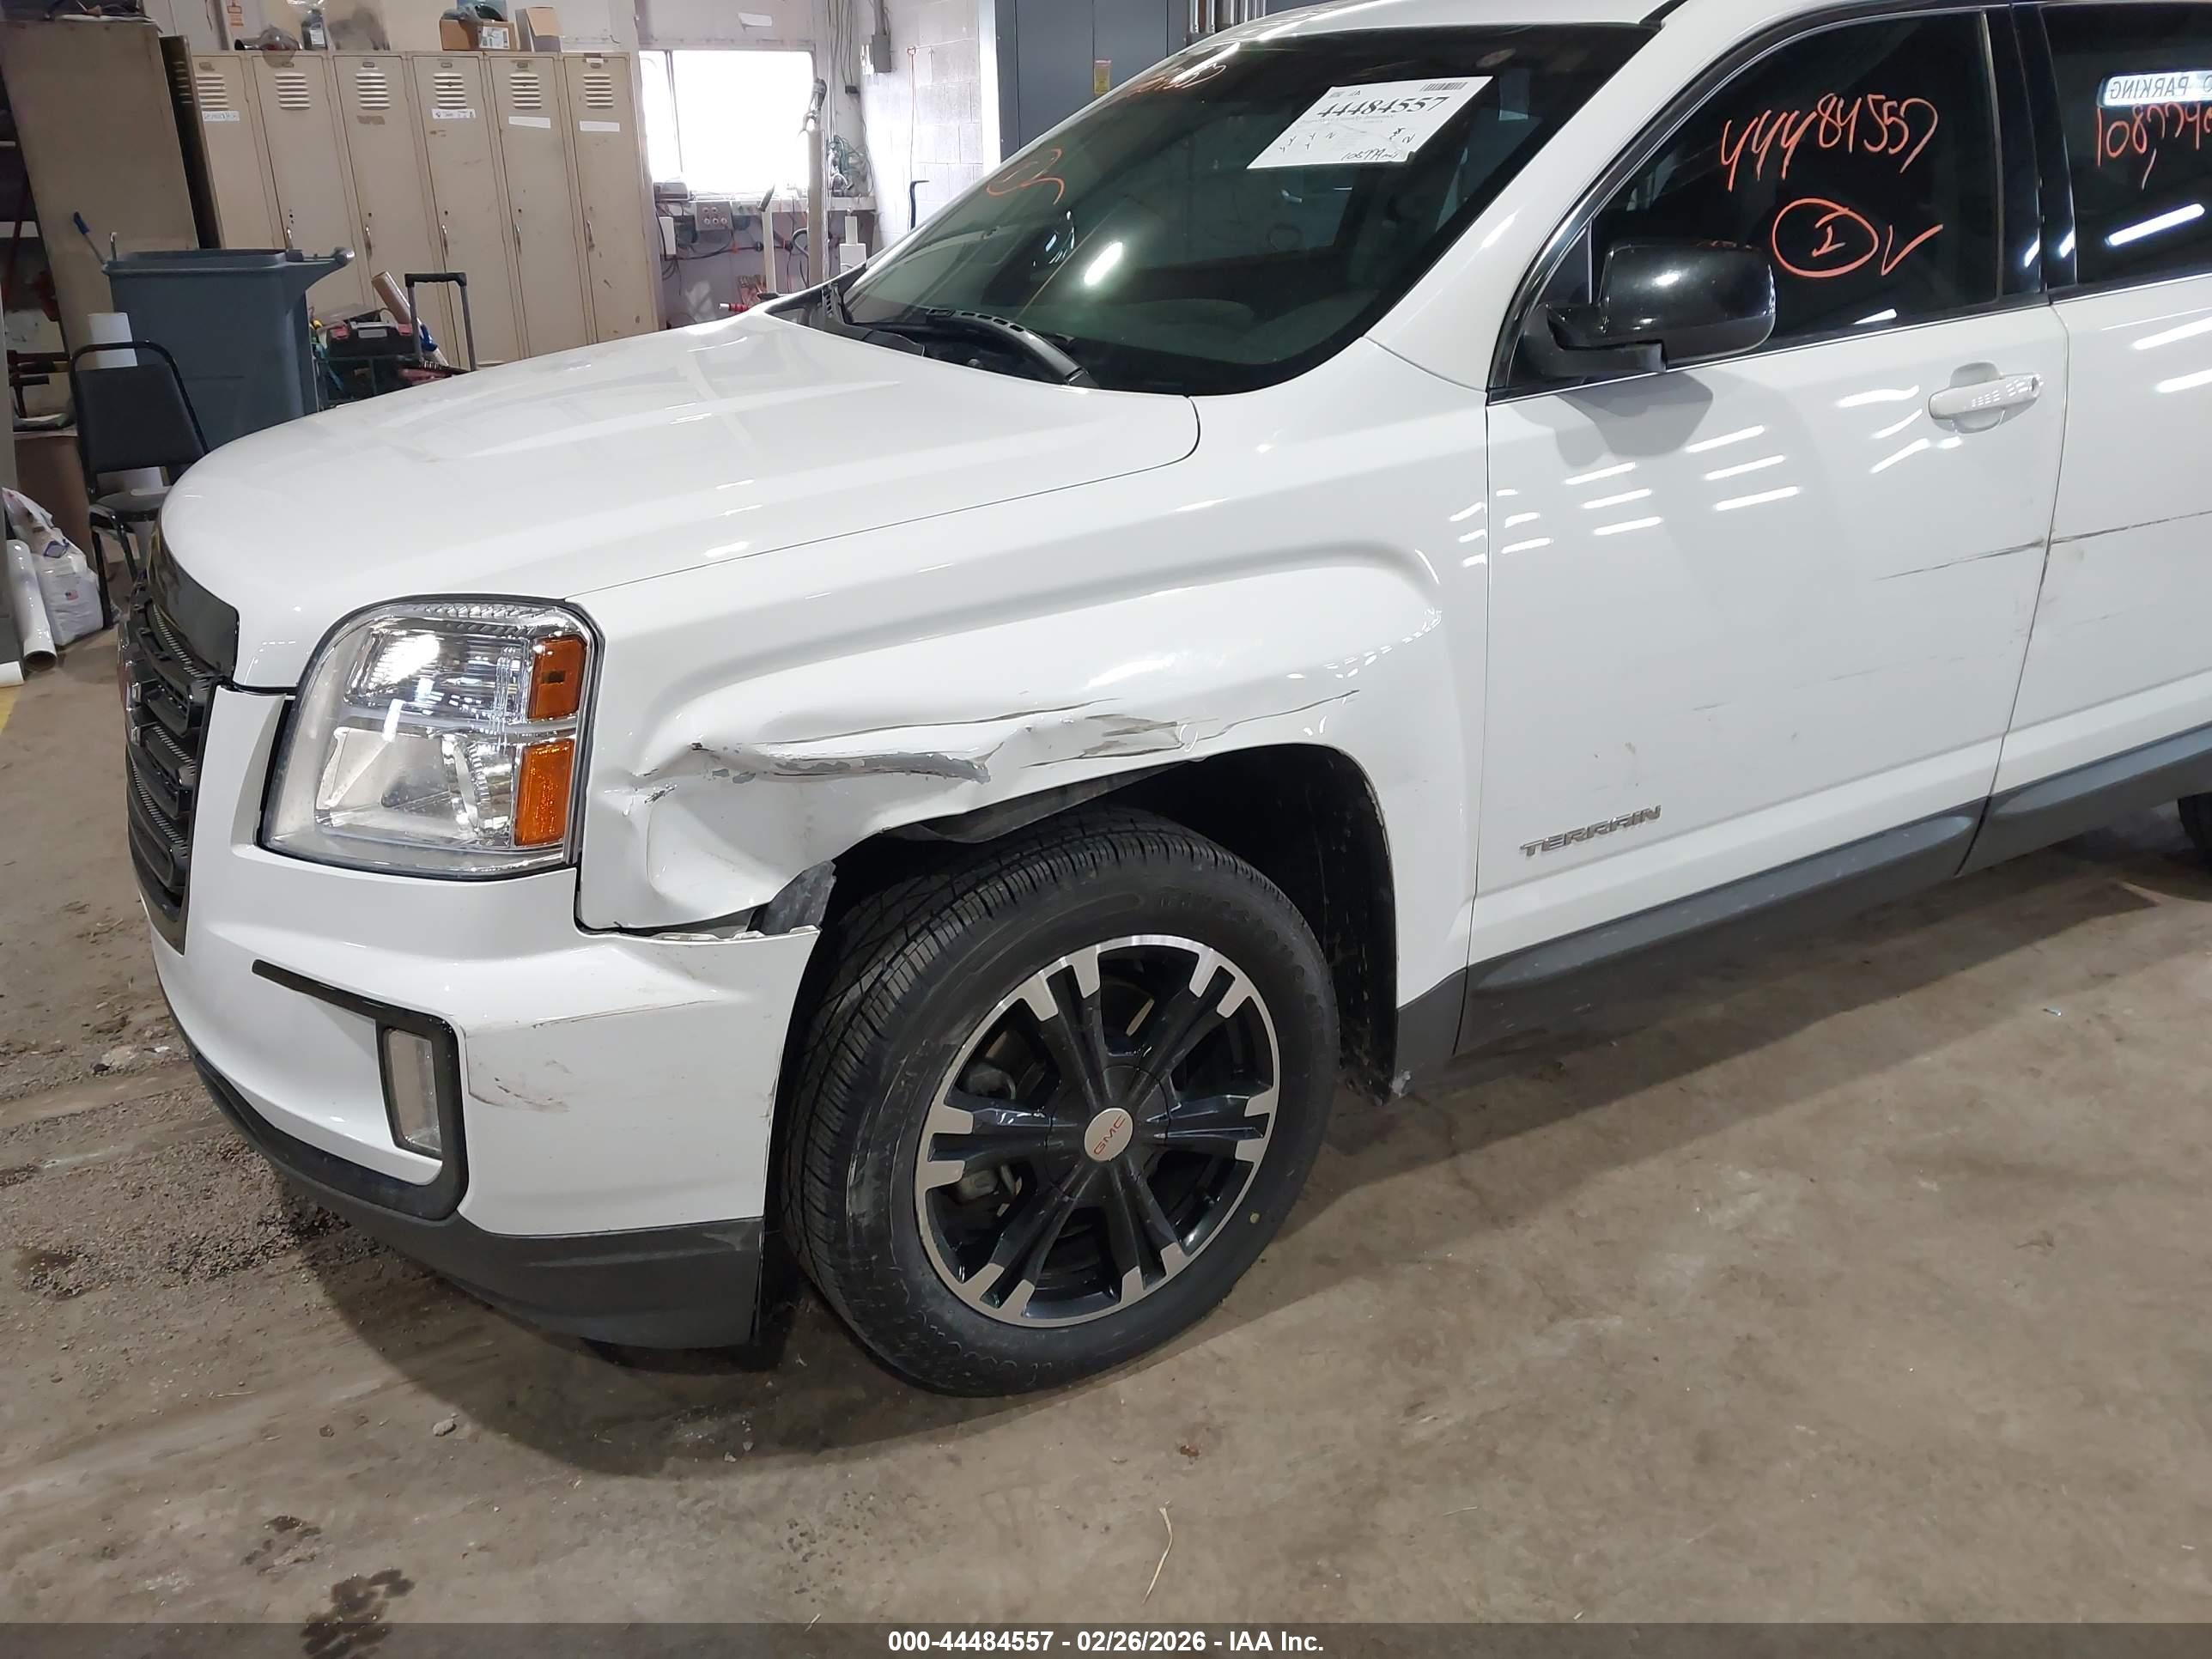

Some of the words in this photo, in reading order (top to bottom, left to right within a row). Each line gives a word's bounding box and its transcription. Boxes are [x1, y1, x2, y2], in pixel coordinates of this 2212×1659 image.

[1317, 96, 1450, 118] 44484557
[1720, 92, 1939, 189] 44484557
[1519, 805, 1662, 857] TERRAIN
[1093, 1114, 1126, 1155] GMC
